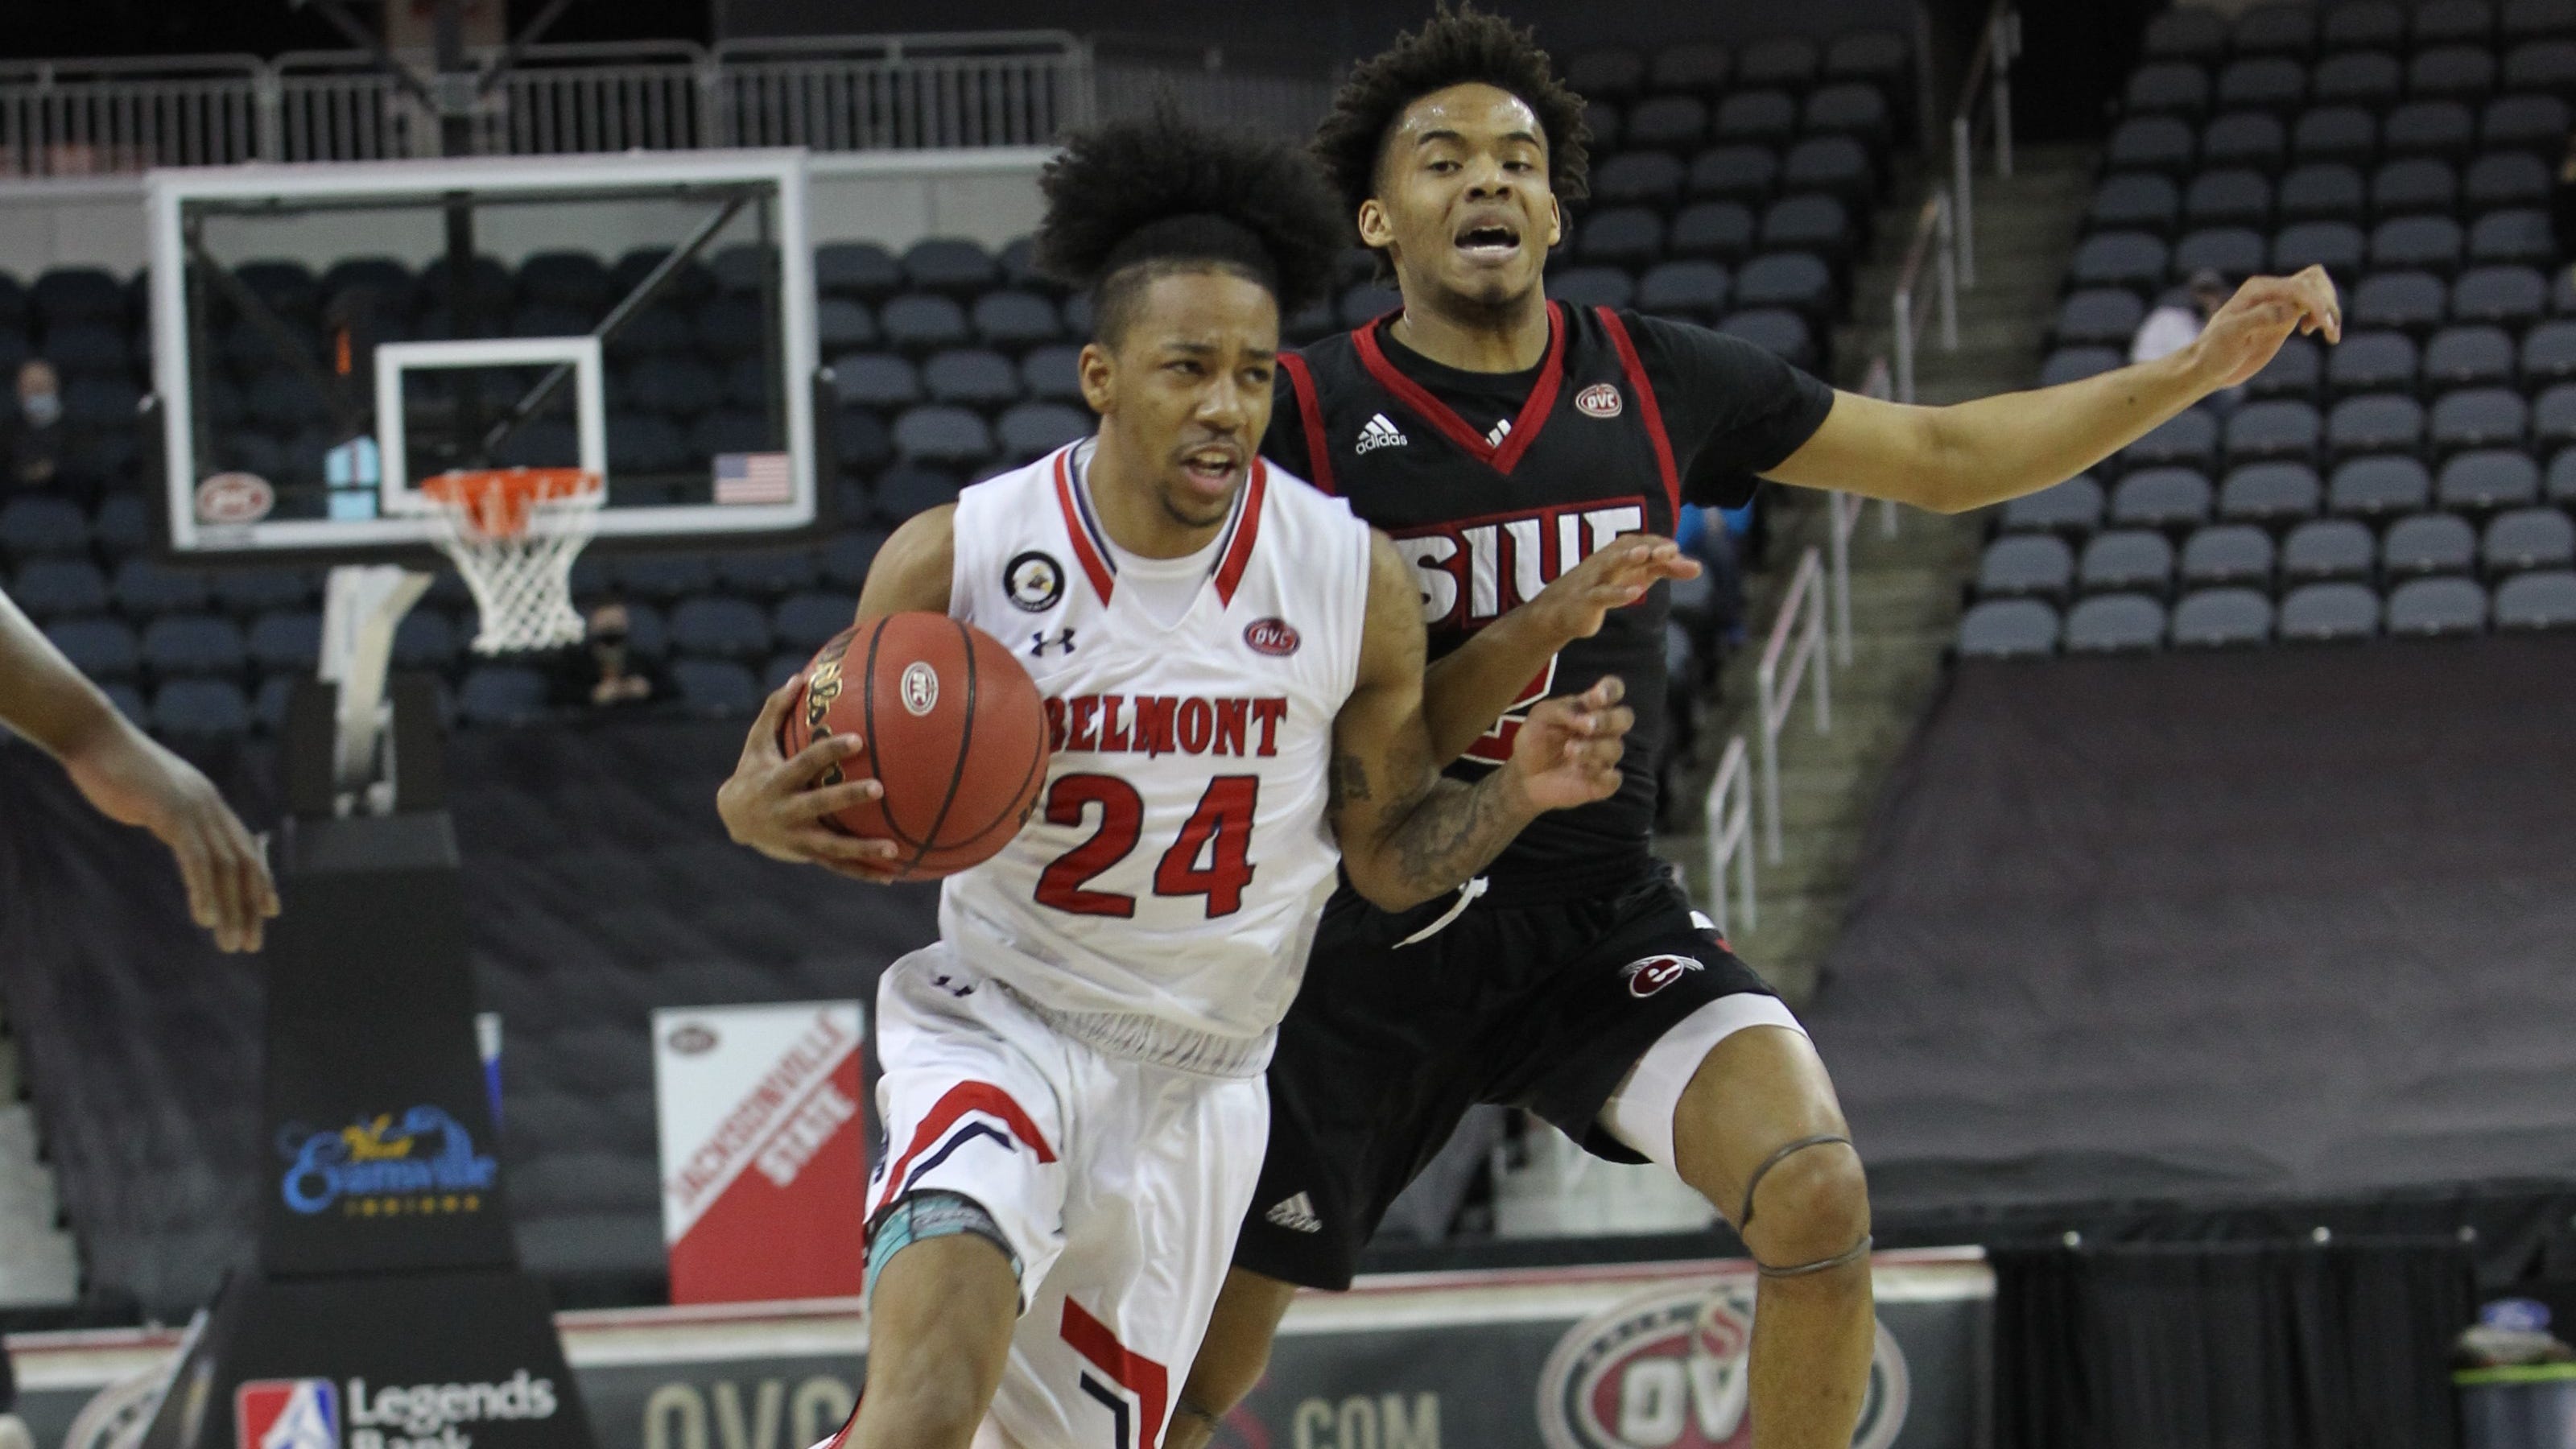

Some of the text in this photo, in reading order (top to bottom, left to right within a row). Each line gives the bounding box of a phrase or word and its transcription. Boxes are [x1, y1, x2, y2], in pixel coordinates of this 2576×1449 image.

[1587, 393, 1616, 409] OVC
[1356, 431, 1408, 456] adidas
[1044, 696, 1287, 758] BELMONT
[1034, 772, 1259, 919] 24
[755, 1078, 857, 1188] STATE
[347, 1368, 558, 1437] Legends
